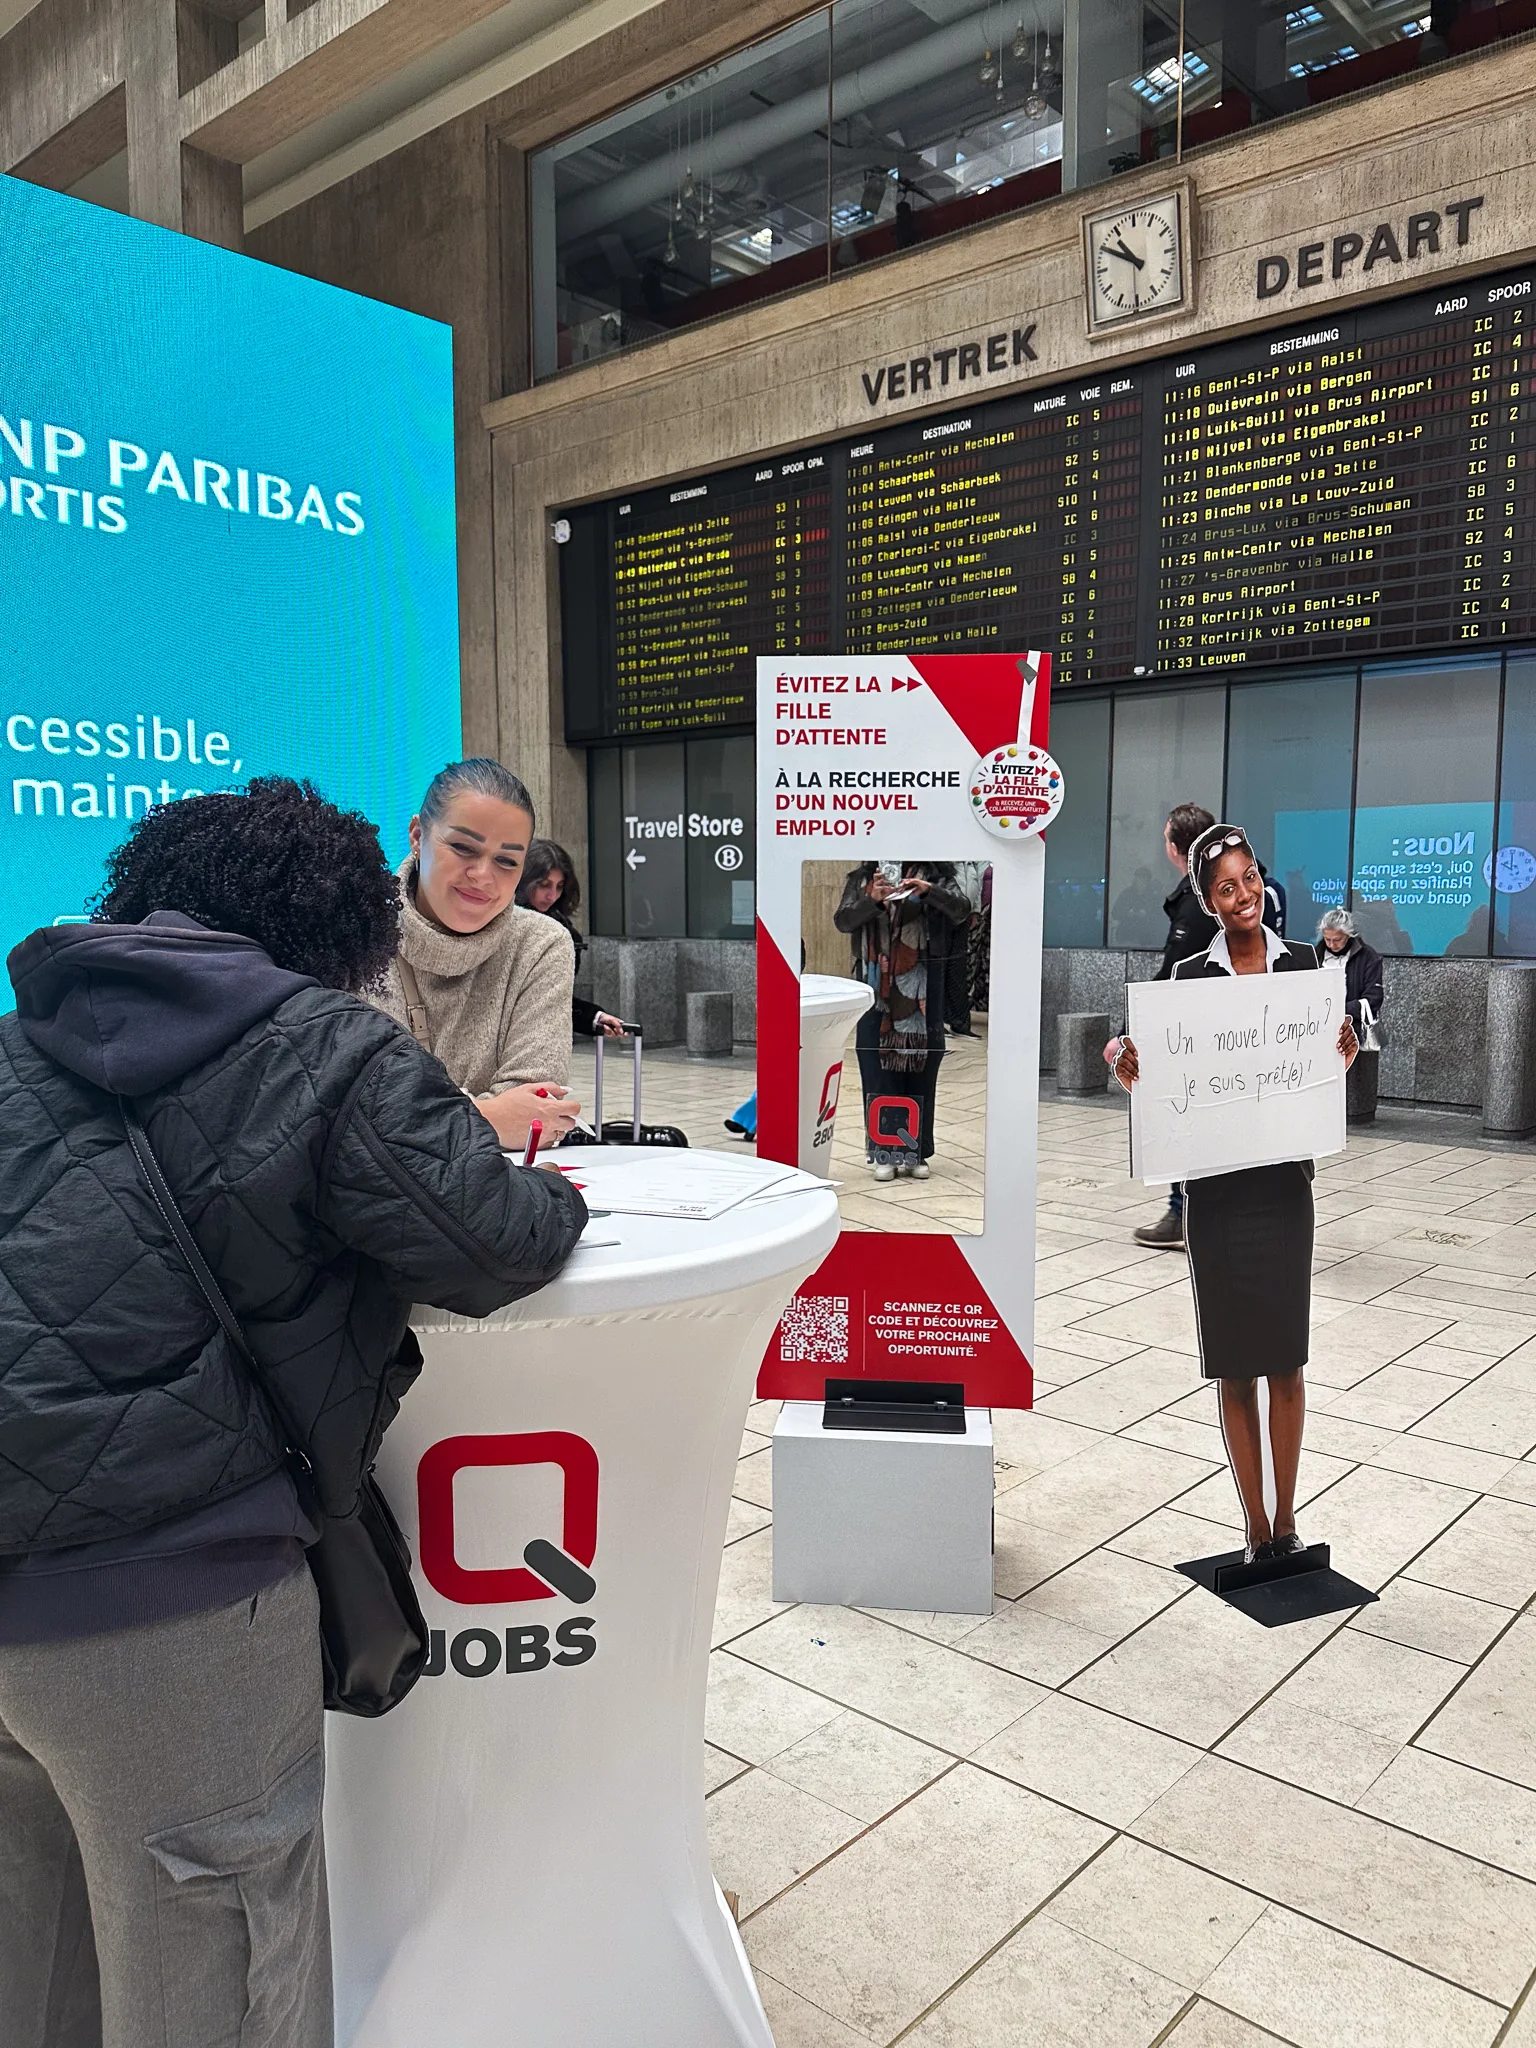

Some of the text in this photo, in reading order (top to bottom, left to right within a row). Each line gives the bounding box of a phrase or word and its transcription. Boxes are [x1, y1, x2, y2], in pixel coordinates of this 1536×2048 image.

[1256, 196, 1486, 299] DEPART
[1175, 281, 1531, 378] UUR BESTEMMING AARD SPOOR
[860, 324, 1040, 406] VERTREK
[1164, 406, 1200, 424] 11:18
[1287, 383, 1312, 398] via
[1320, 370, 1372, 391] Bergen
[1473, 341, 1492, 357] IC
[1512, 334, 1522, 347] 4
[1165, 310, 1522, 404] 11:16 Gent-St-P via Aalst IC 2
[850, 379, 1134, 458] HEURE DESTINATION NATURE VOIE REM.
[1163, 383, 1520, 466] 11:18 Nijvel via Eigenbrakel S1 6
[1164, 358, 1518, 446] 11:18 Luik-Guill via Brus Airport IC 1
[1163, 407, 1518, 486] 11:21 Blankenberge via Gent-St-P IC 2
[108, 438, 365, 536] PARIBAS
[619, 456, 824, 515] UUR BESTEMMING AARD SPOOR OPM.
[847, 468, 935, 497] 11:04 Schaarbeek
[847, 470, 1099, 532] 11:06 Edingen via Halle IC 4
[1162, 455, 1516, 528] 11:23 Binche via La Louv-Zuid IC 6
[847, 554, 873, 568] 11:07
[946, 535, 964, 548] via
[969, 521, 1037, 545] Eigenbrakel
[1064, 514, 1078, 526] IC
[1091, 510, 1098, 521] 6
[1157, 598, 1509, 650] 11:32 Kortrijk via Zottegem IC 4
[1158, 574, 1510, 630] 11:28 Kortrijk via Gent-St-P IC 2
[1157, 621, 1506, 671] 11:33 Leuven IC 1
[776, 672, 881, 693] ÉVITEZ LA
[776, 703, 832, 720] FILLE
[776, 728, 887, 745] D'ATTENTE
[0, 713, 244, 774] cessible,
[992, 760, 1034, 775] ÉVITEZ
[775, 768, 960, 788] À LA RECHERCHE
[776, 794, 918, 810] D'UN NOUVEL
[983, 784, 1049, 796] D'ATTENTE
[994, 775, 1038, 786] LA FILE
[624, 813, 744, 839] Travel Store
[776, 819, 875, 836] EMPLOI ?
[1166, 1021, 1193, 1055] Un
[1213, 1004, 1268, 1052] nouvel
[1208, 1073, 1246, 1094] suis
[867, 1095, 920, 1150] Q
[867, 1150, 919, 1168] JOBS
[868, 1314, 998, 1329] CODE ET DÉCOUVREZ
[883, 1302, 982, 1316] SCANNEZ CE QR
[875, 1329, 991, 1343] VOTRE PROCHAINE
[888, 1344, 978, 1357] OPPORTUNITÉ.
[416, 1430, 600, 1605] Q
